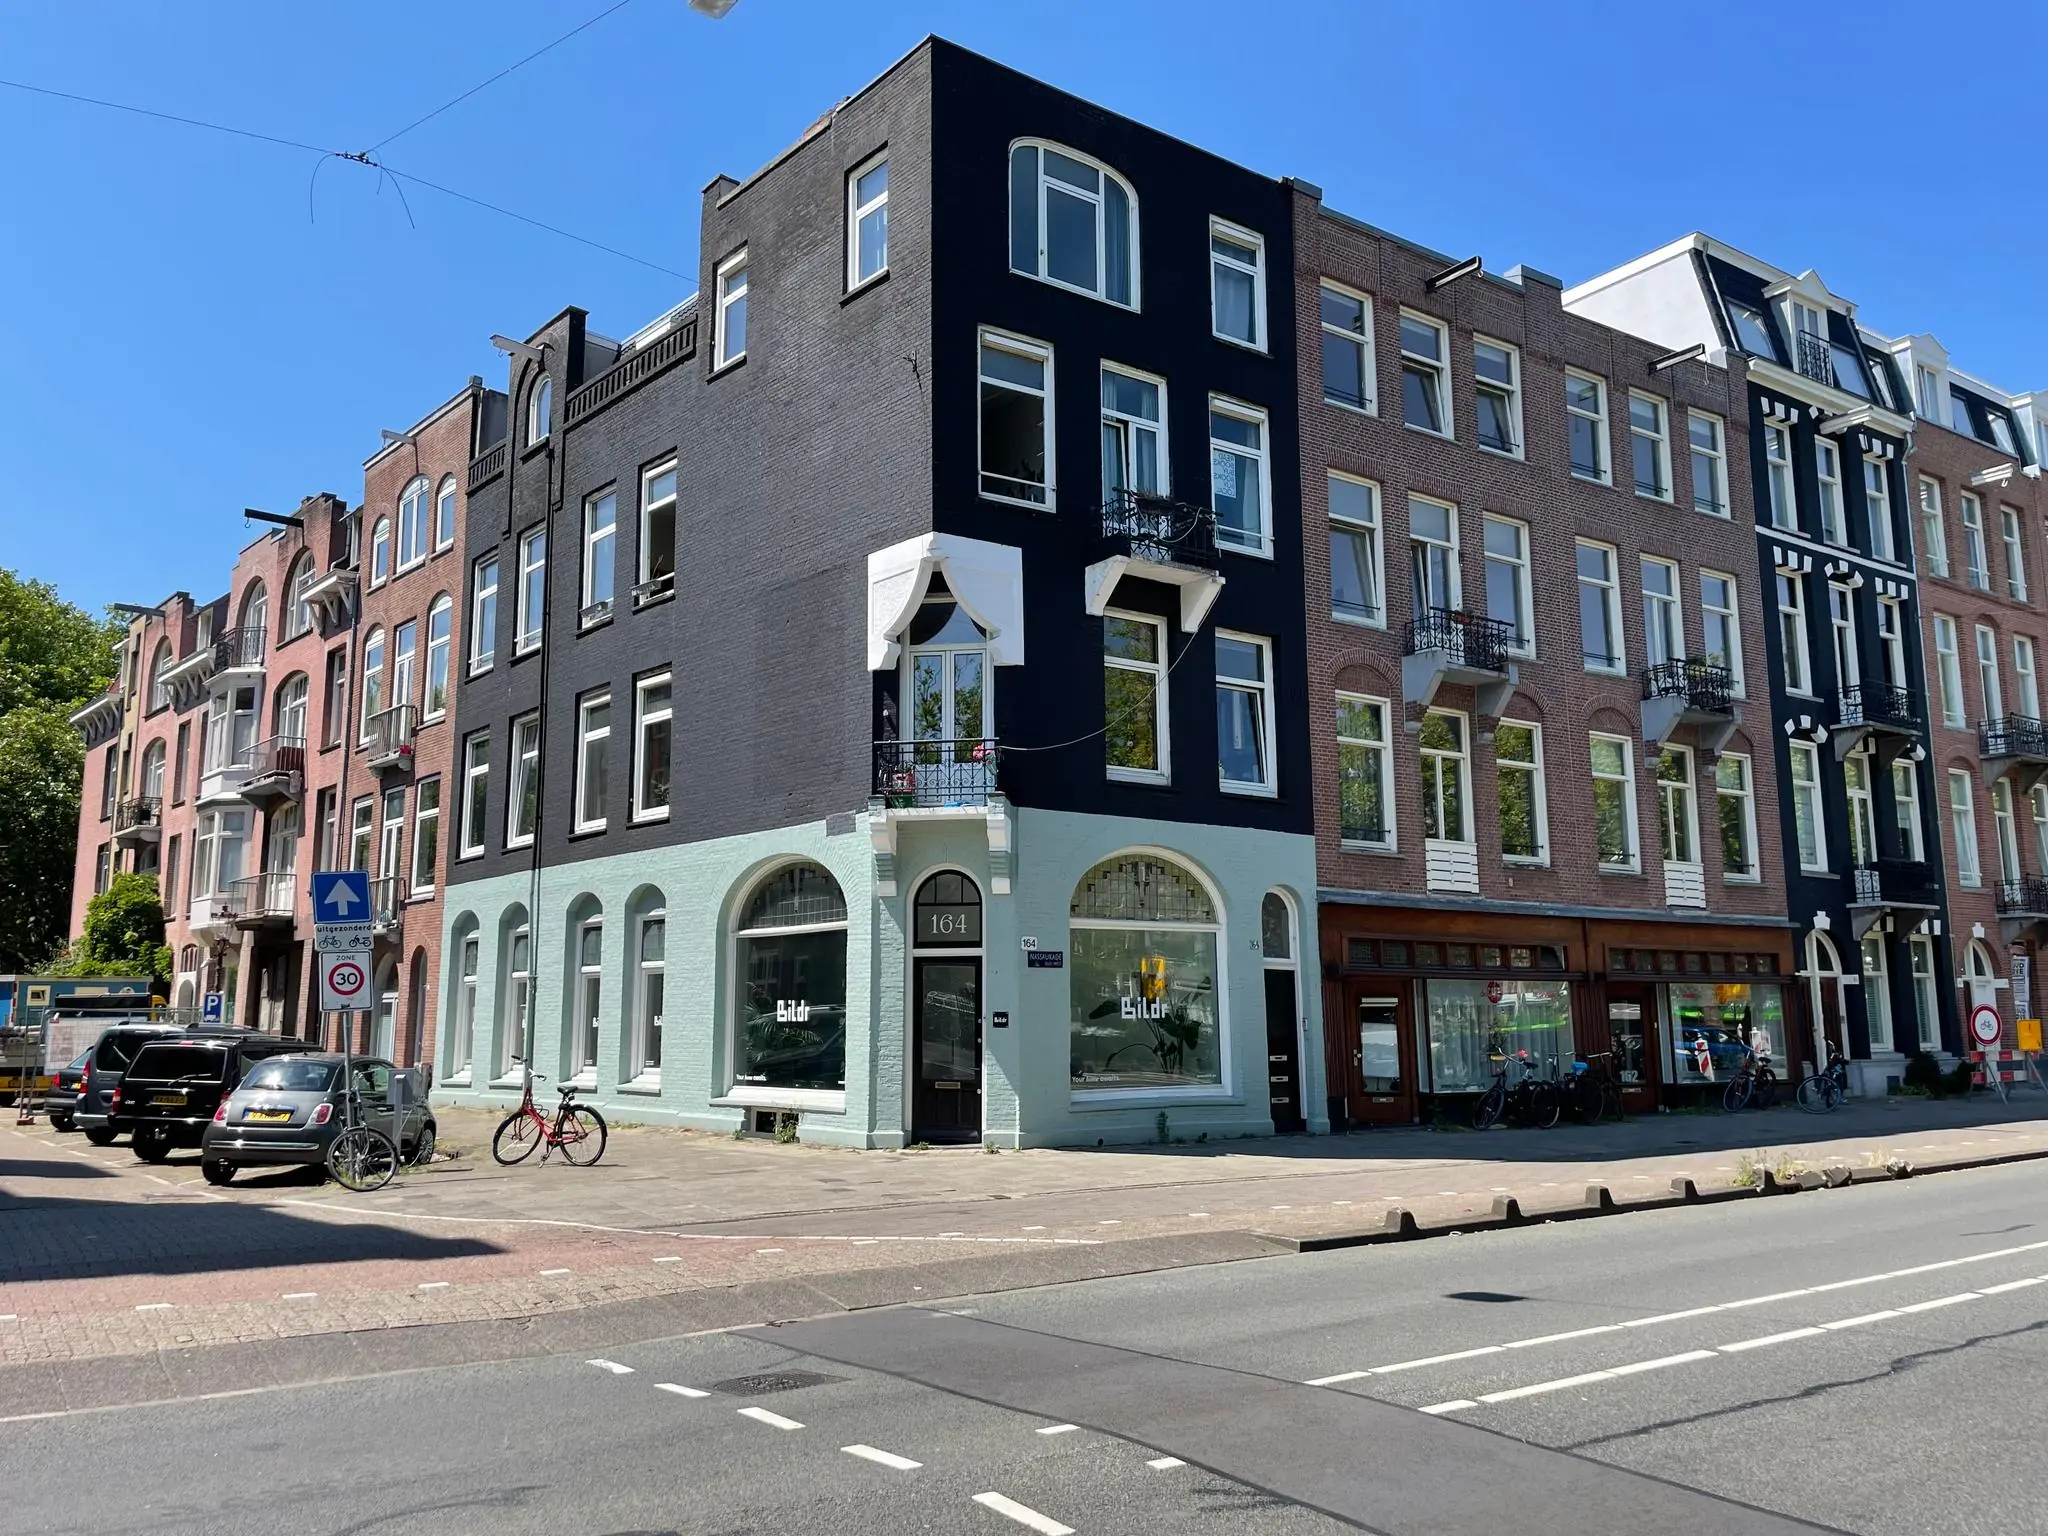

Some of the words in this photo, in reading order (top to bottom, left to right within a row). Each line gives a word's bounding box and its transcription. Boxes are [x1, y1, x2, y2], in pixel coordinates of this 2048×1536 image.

[317, 924, 371, 933] uitgezonderd
[930, 914, 967, 934] 164
[1023, 938, 1036, 948] 164
[336, 973, 358, 985] 30
[207, 995, 219, 1011] P
[1121, 997, 1169, 1020] Bildr
[777, 1000, 810, 1022] Bildr
[1619, 1070, 1638, 1082] 162
